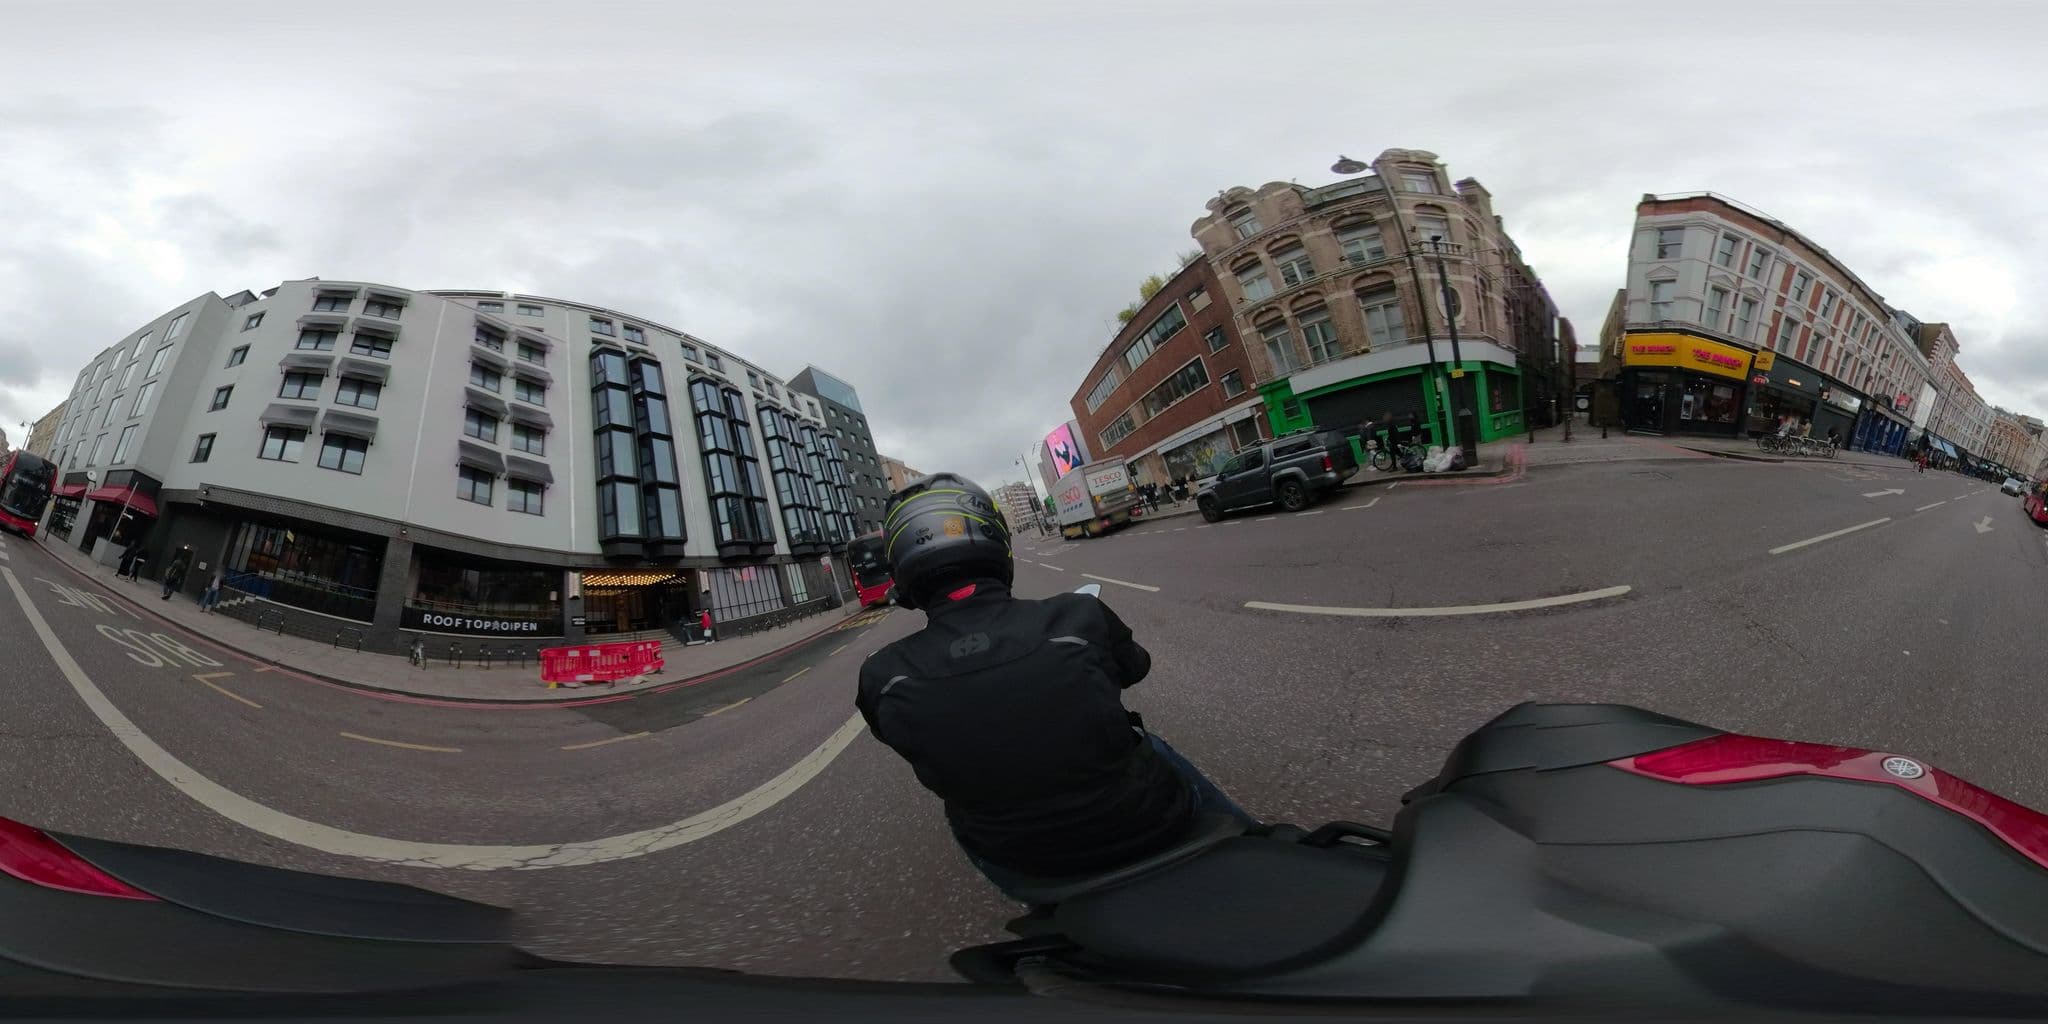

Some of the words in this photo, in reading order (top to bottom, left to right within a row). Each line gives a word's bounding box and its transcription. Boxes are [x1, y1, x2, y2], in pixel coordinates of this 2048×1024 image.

[1093, 471, 1122, 485] TESCO
[1057, 485, 1081, 506] TESCO
[422, 613, 491, 631] ROOFTOP
[95, 624, 224, 668] BUS
